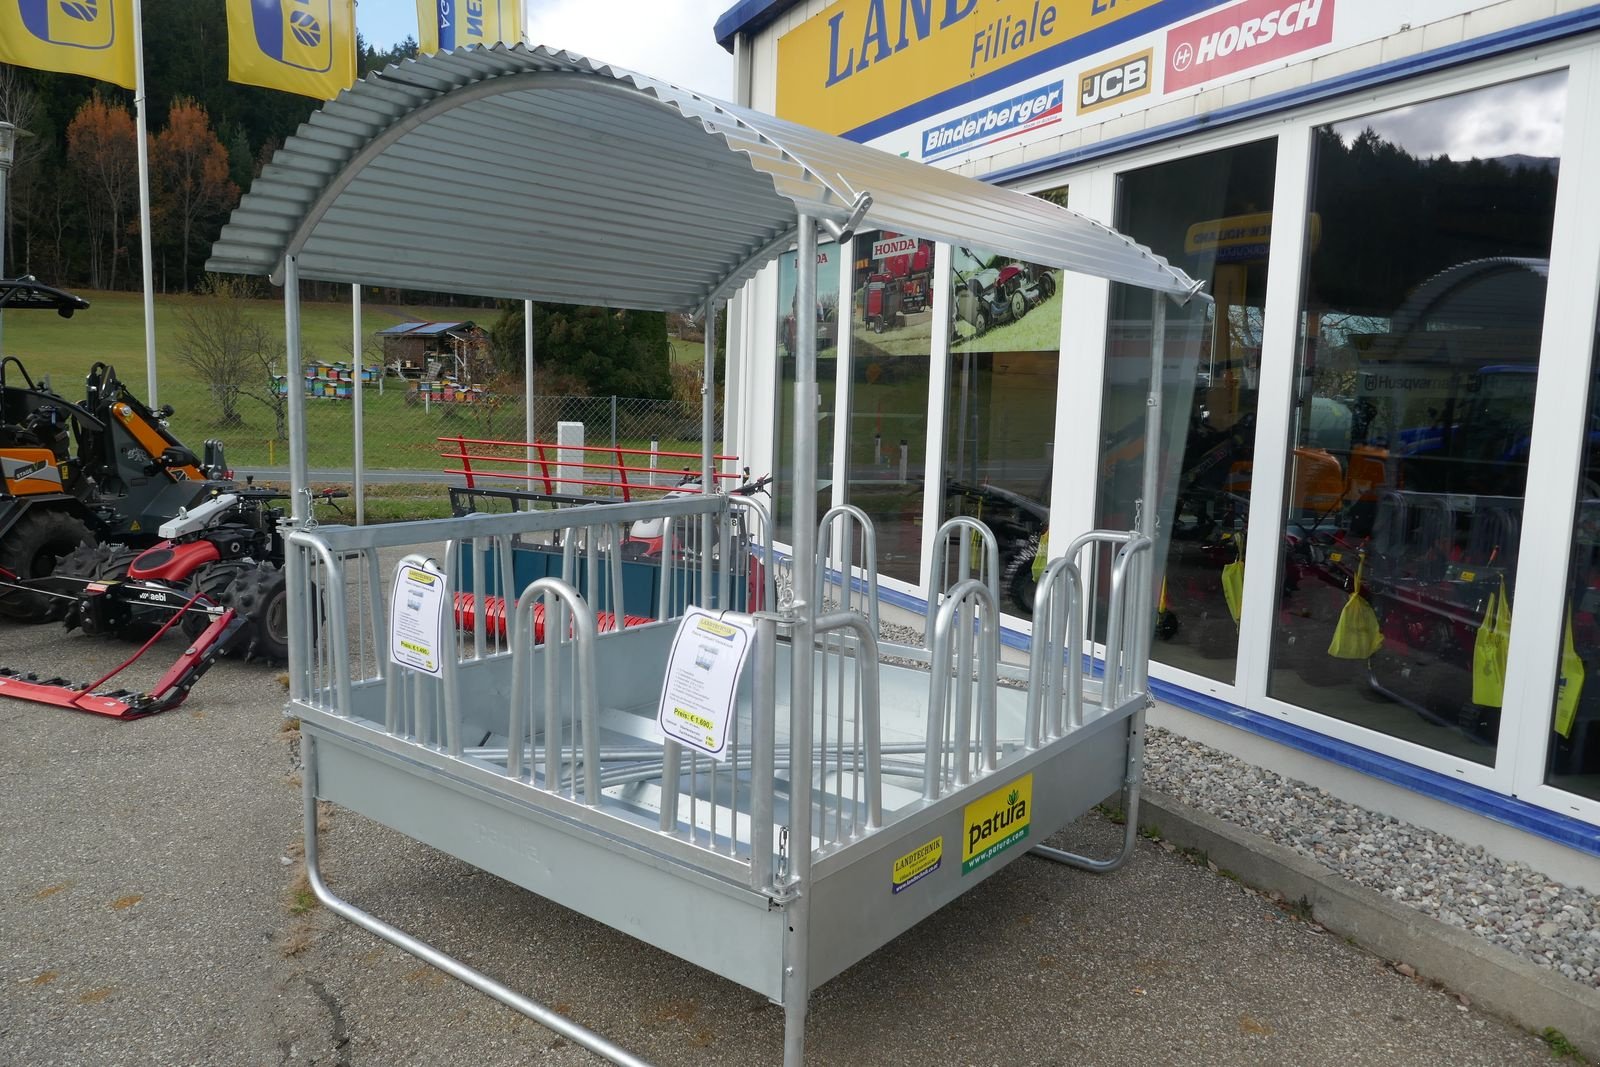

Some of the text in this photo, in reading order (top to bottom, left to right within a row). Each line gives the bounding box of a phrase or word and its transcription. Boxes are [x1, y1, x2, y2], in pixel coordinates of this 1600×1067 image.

[970, 1, 1057, 69] Filiale
[1196, 0, 1322, 64] HORSCH
[1083, 60, 1147, 105] JCB
[925, 89, 1060, 152] Binderberger
[874, 238, 916, 256] HONDA
[15, 467, 33, 479] STAGE
[150, 593, 166, 602] aebi
[674, 707, 689, 720] Preis:
[969, 799, 1026, 854] patura
[895, 839, 941, 872] LANDTECHNIK
[968, 829, 1025, 868] www.patura.com
